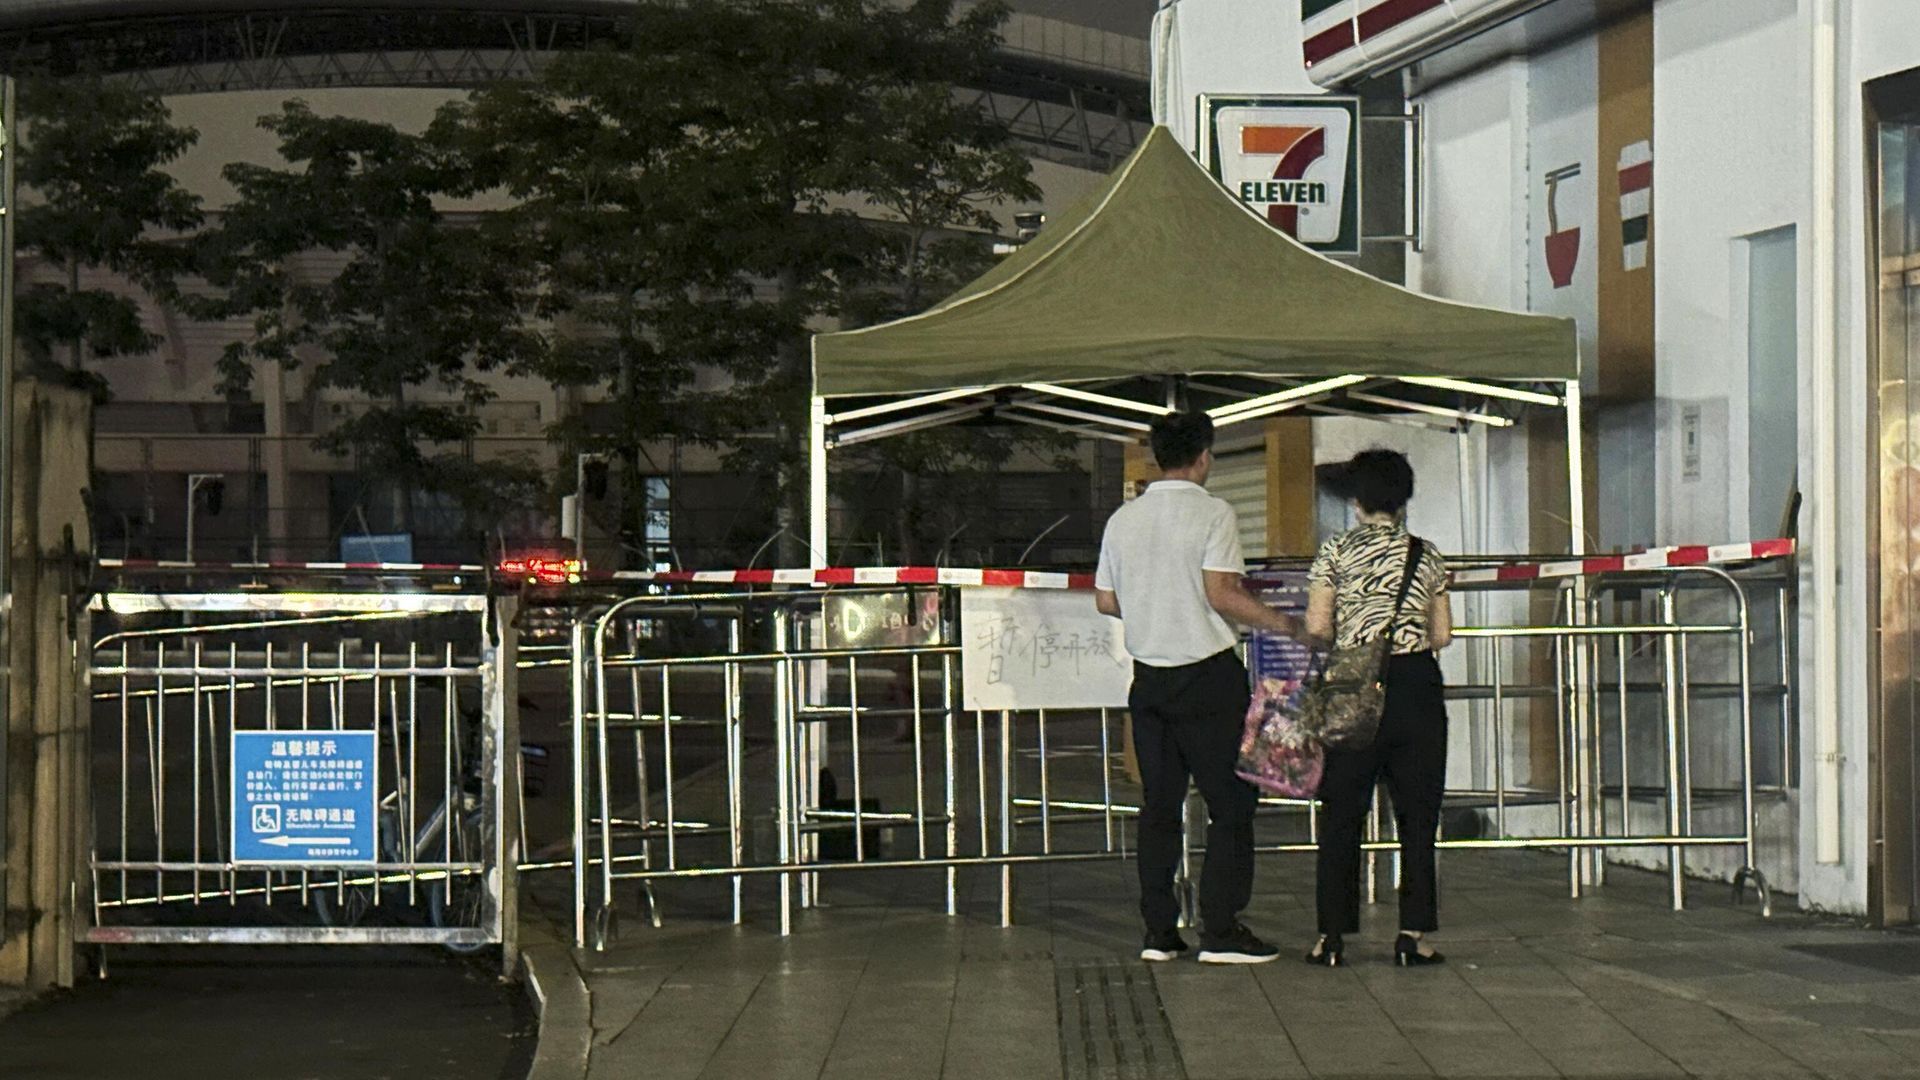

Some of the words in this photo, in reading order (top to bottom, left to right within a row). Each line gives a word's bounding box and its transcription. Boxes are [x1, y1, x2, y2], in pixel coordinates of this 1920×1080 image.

[1241, 126, 1325, 239] 7
[977, 616, 1124, 685] 暂停开放
[271, 740, 337, 756] 温馨提示
[285, 808, 356, 822] 无障碍通道
